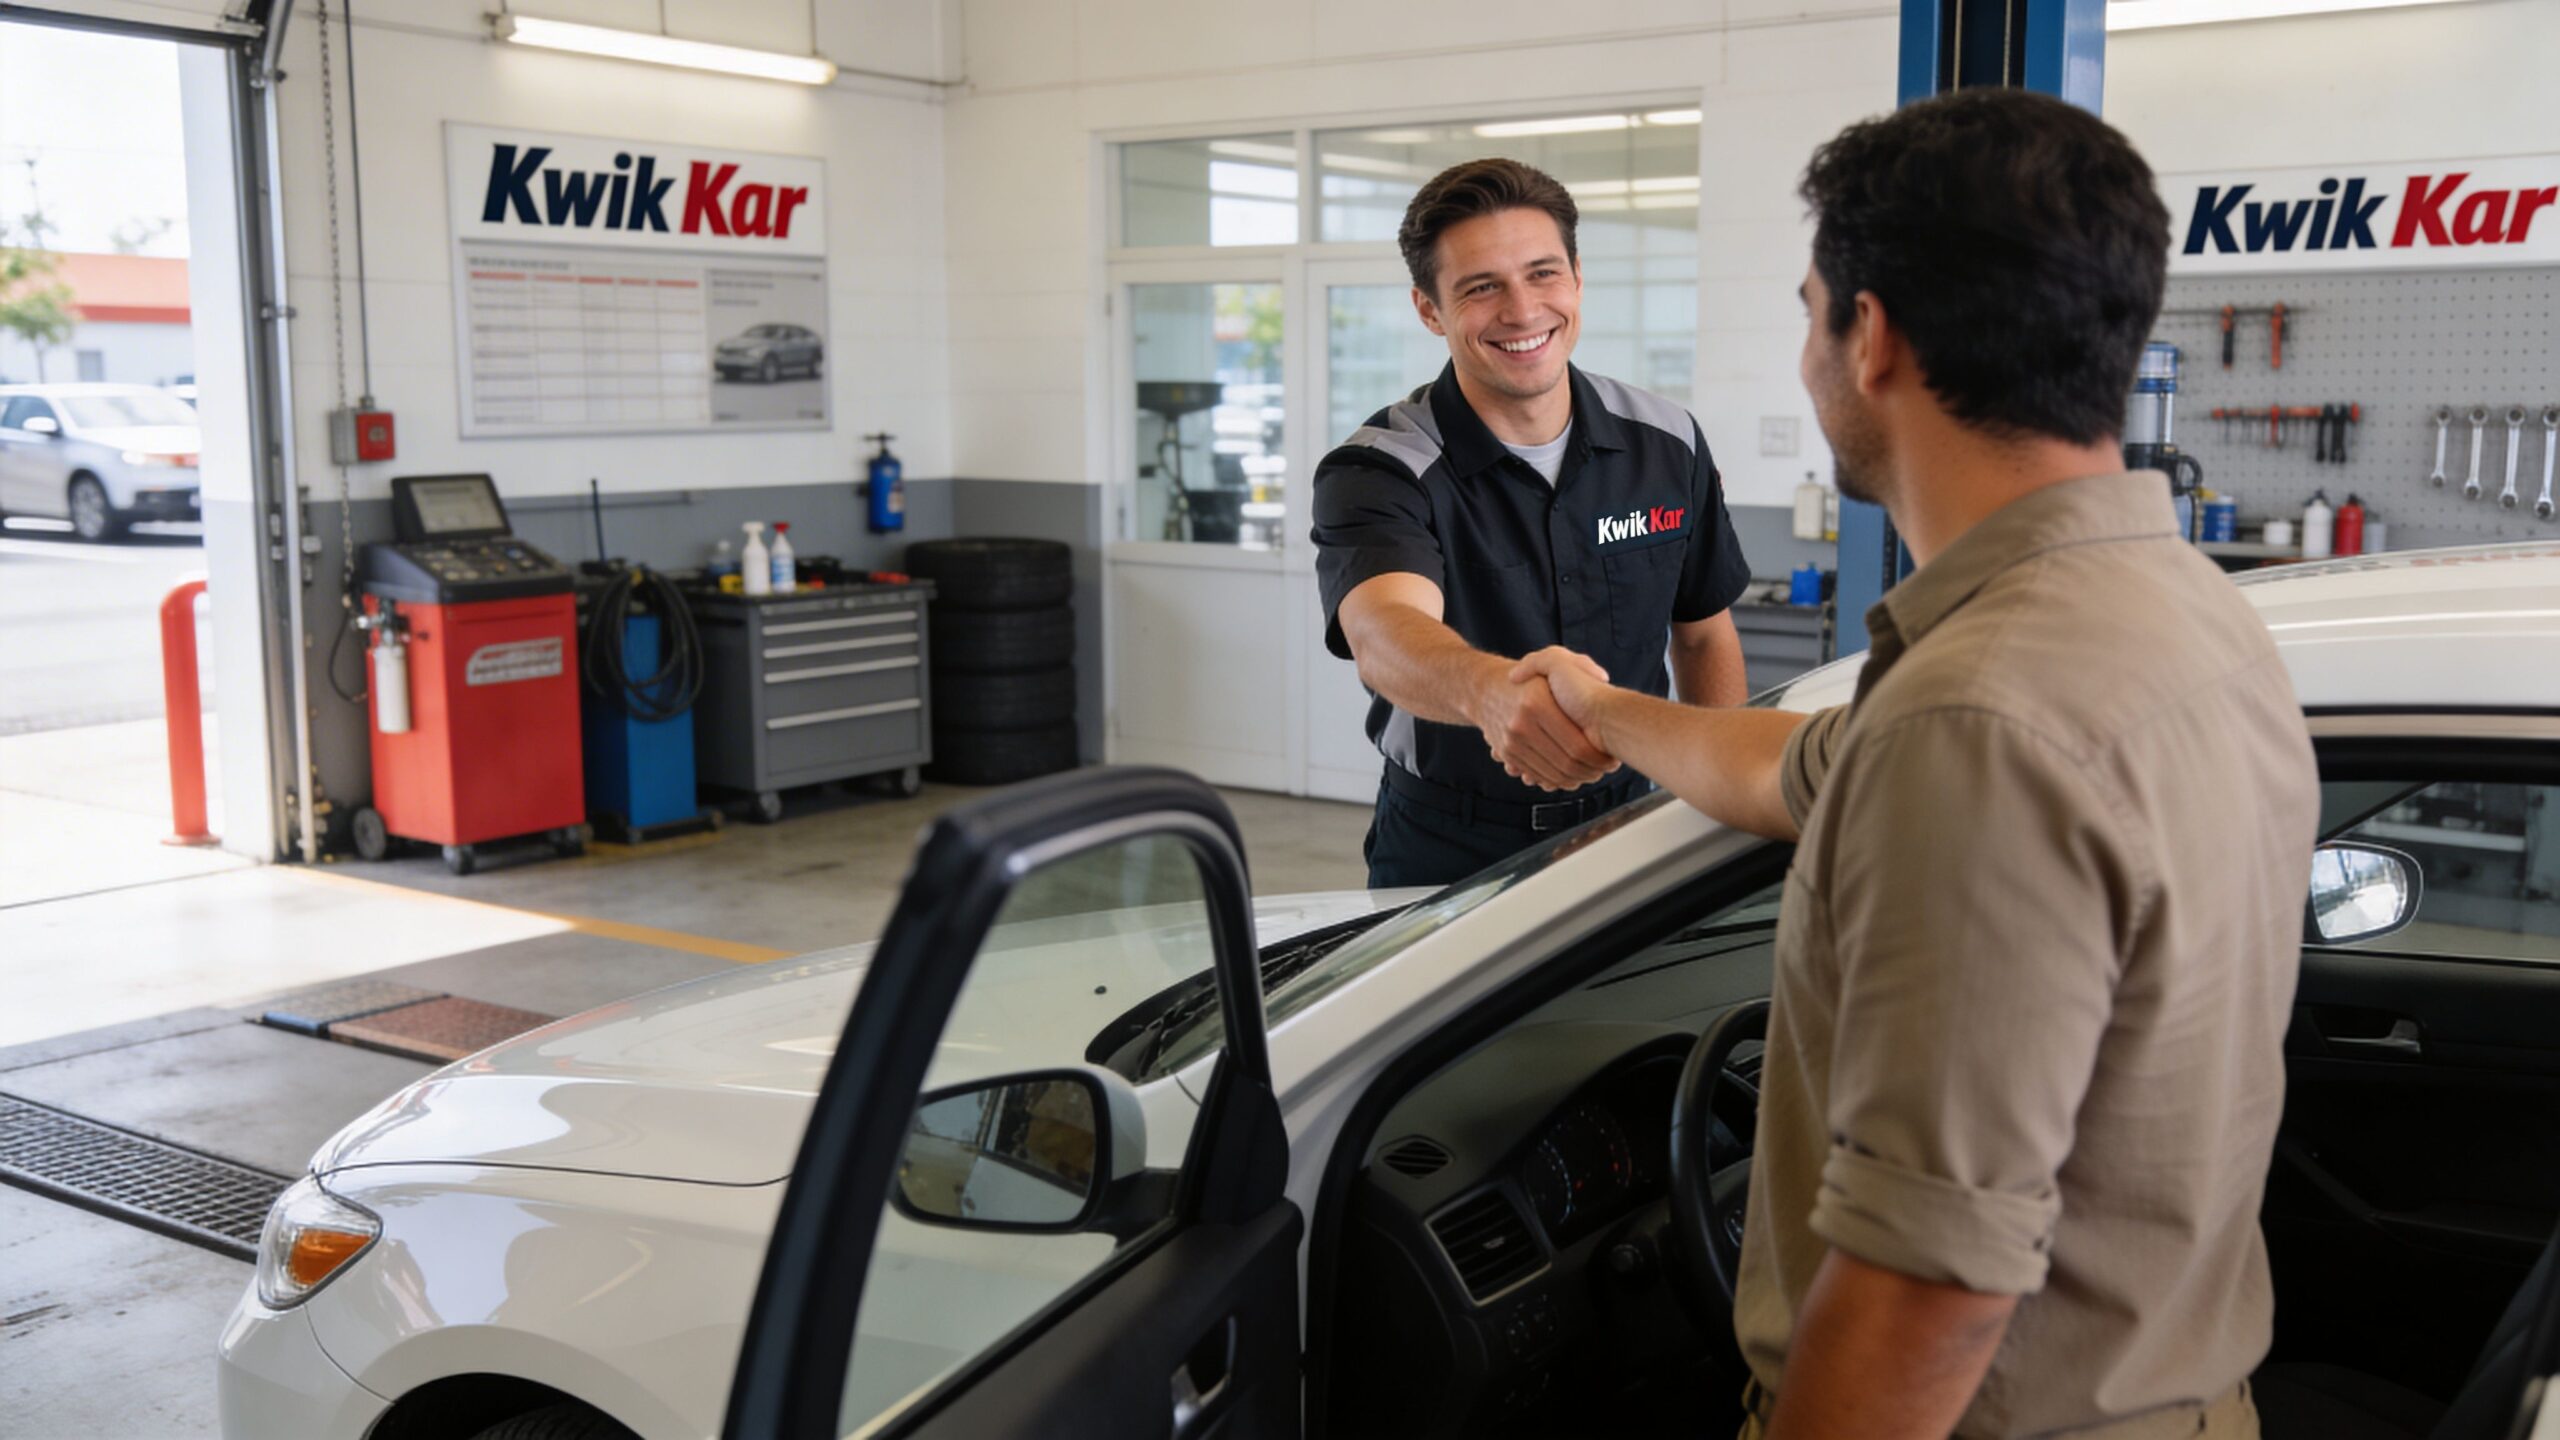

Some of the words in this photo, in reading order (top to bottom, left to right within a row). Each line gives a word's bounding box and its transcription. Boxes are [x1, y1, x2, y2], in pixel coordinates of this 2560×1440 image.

[481, 143, 677, 233] Kwik
[680, 160, 809, 239] Kar
[2182, 177, 2389, 255] Kwik
[2390, 172, 2560, 249] Kar
[1597, 510, 1649, 545] Kwik
[1649, 505, 1685, 533] Kar
